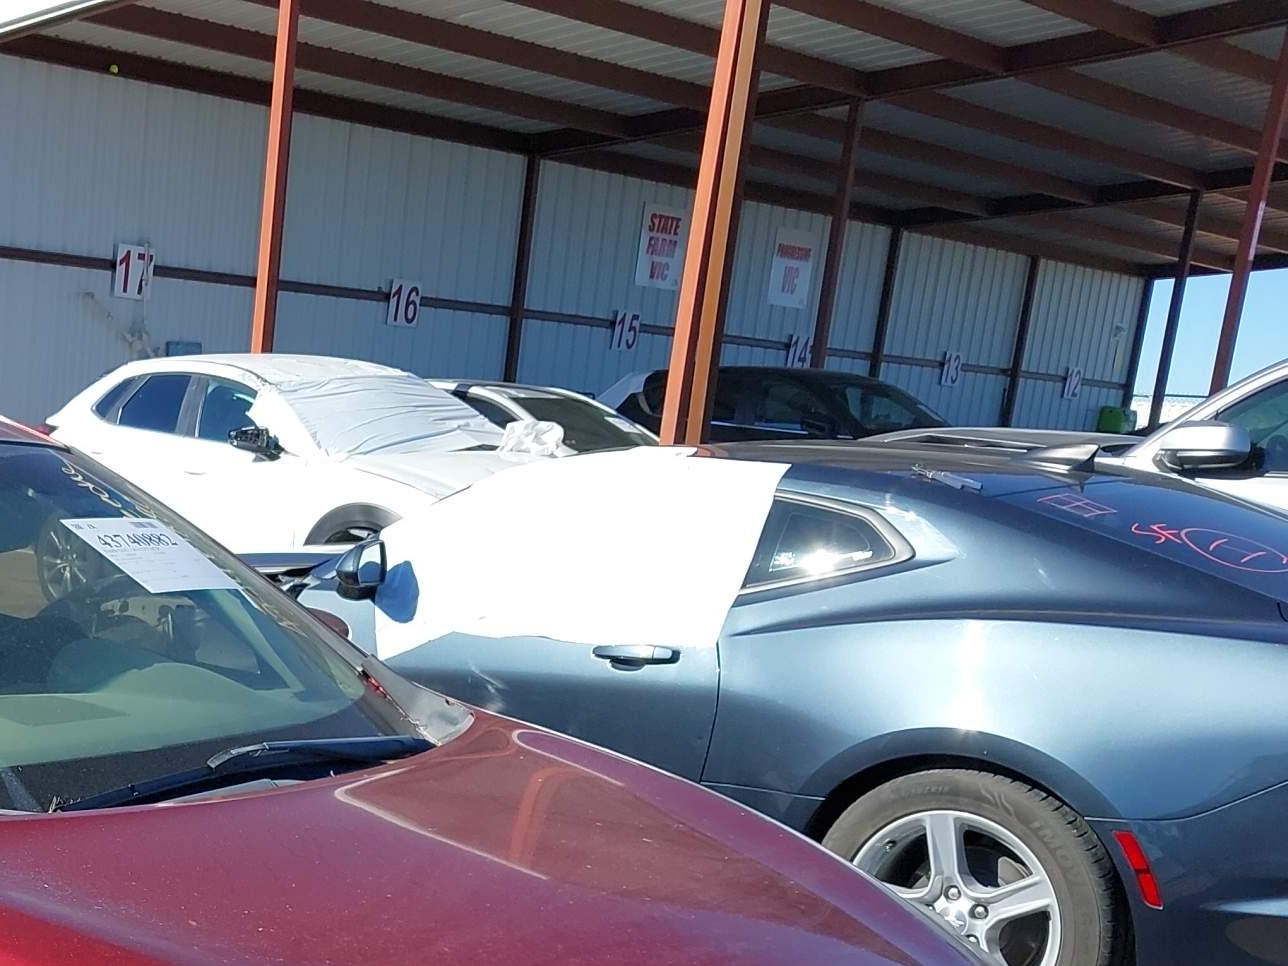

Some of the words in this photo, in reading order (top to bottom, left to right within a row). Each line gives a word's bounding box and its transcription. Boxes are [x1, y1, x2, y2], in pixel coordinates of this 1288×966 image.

[648, 213, 682, 236] STATE
[646, 236, 678, 258] FARM
[119, 249, 154, 295] 17
[649, 260, 670, 280] VIC
[392, 284, 419, 324] 16
[618, 312, 640, 349] 15
[792, 335, 810, 368] 14
[945, 352, 961, 385] 13
[1067, 368, 1081, 398] 12
[97, 533, 178, 548] 43740882
